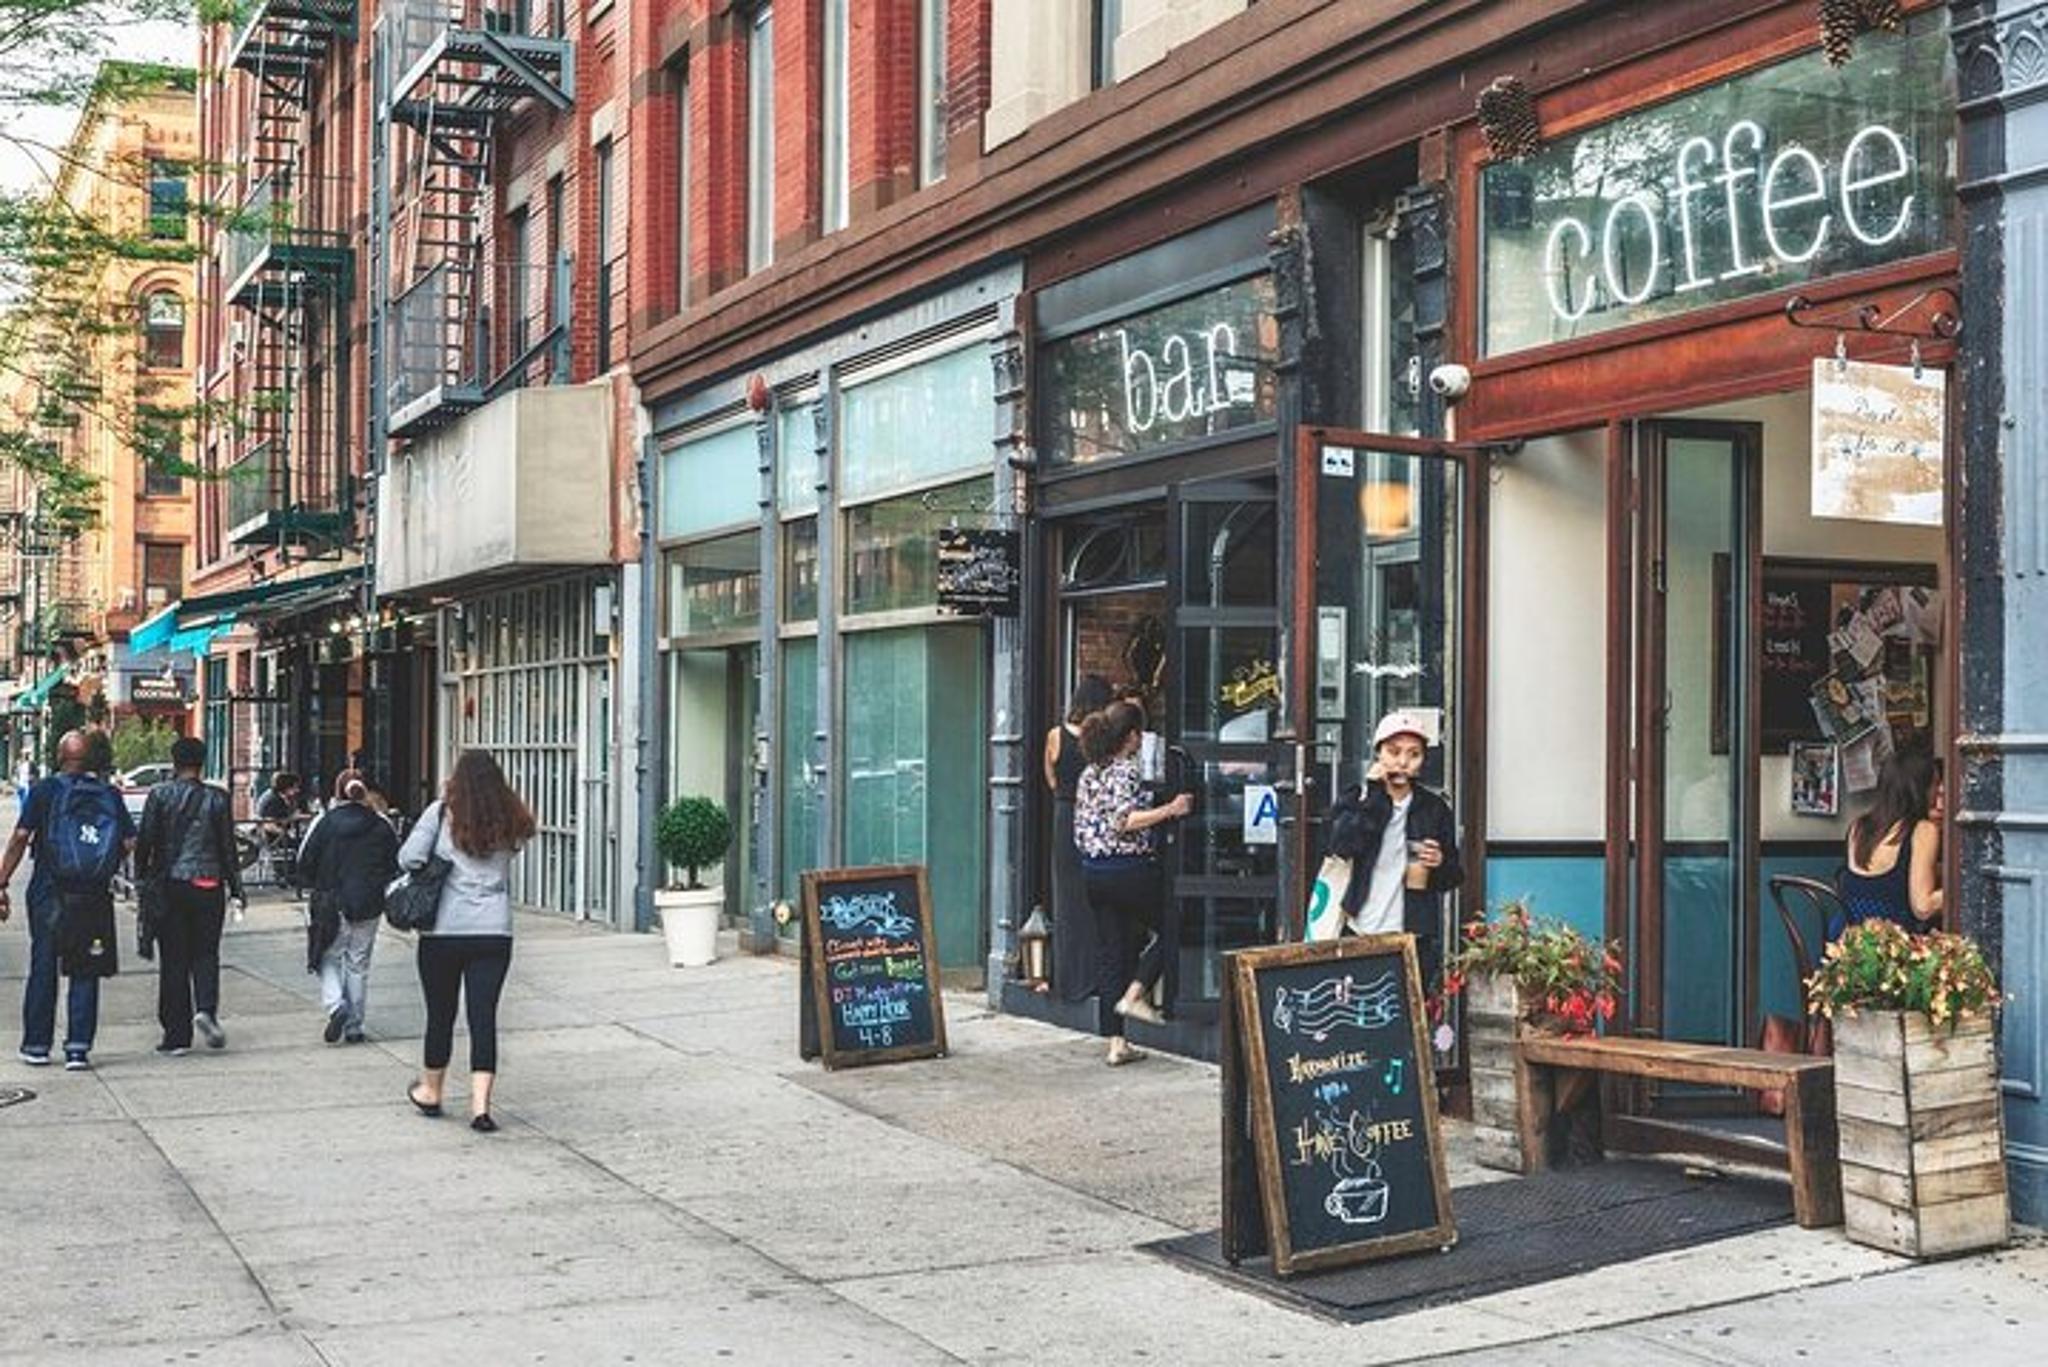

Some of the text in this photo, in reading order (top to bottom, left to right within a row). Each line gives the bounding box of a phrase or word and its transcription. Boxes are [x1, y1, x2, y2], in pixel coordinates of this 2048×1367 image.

[1545, 119, 1915, 320] coffee
[1115, 322, 1236, 433] bar
[1253, 791, 1280, 827] A
[859, 1025, 893, 1046] 4-8
